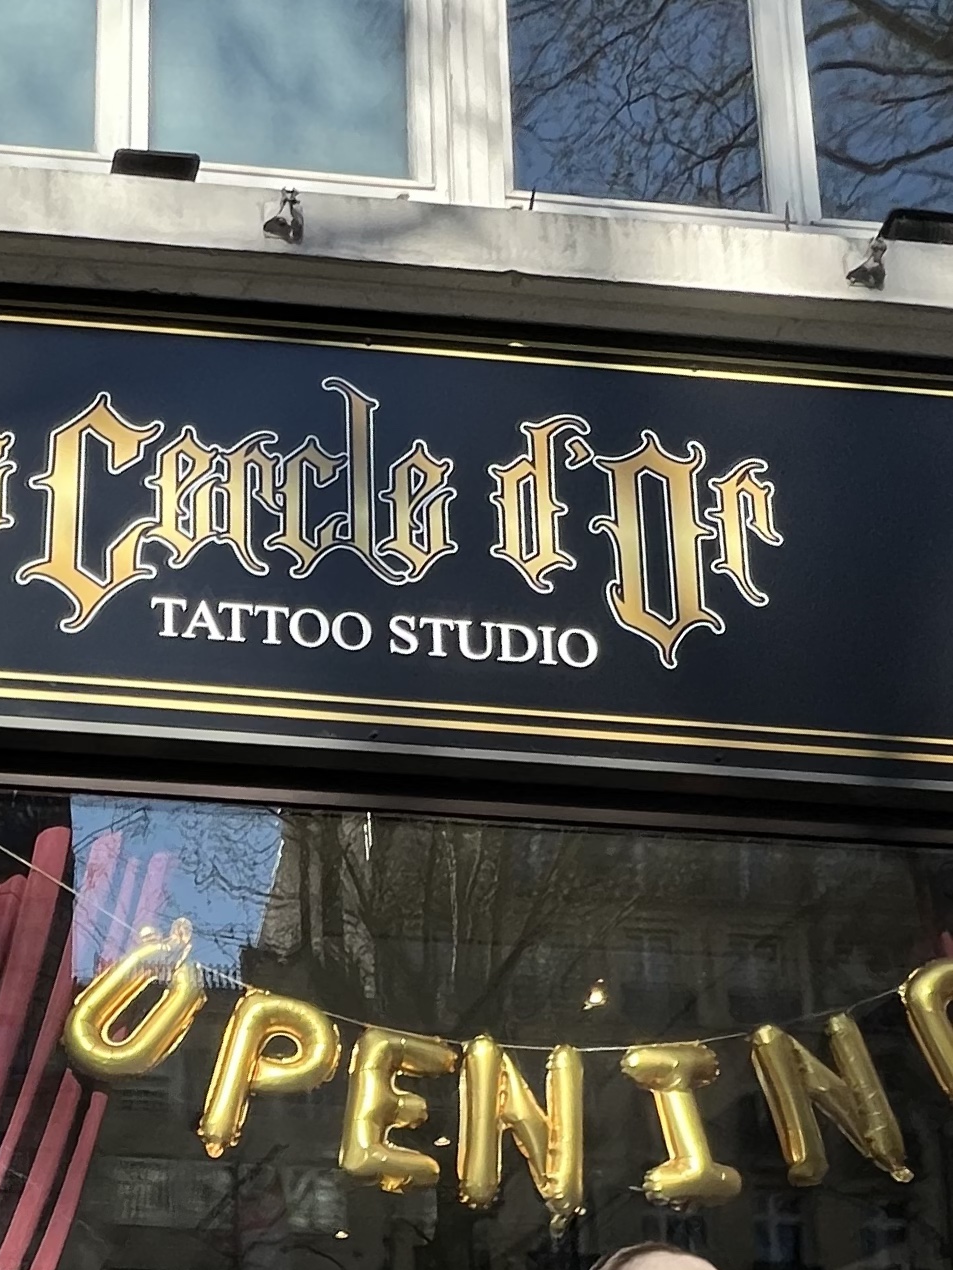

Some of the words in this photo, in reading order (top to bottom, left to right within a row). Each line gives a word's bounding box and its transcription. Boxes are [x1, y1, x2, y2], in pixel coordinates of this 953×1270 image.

[15, 376, 459, 635] Cercle
[488, 414, 784, 669] d'Or
[150, 596, 373, 652] TATTOO
[389, 614, 599, 669] STUDIO
